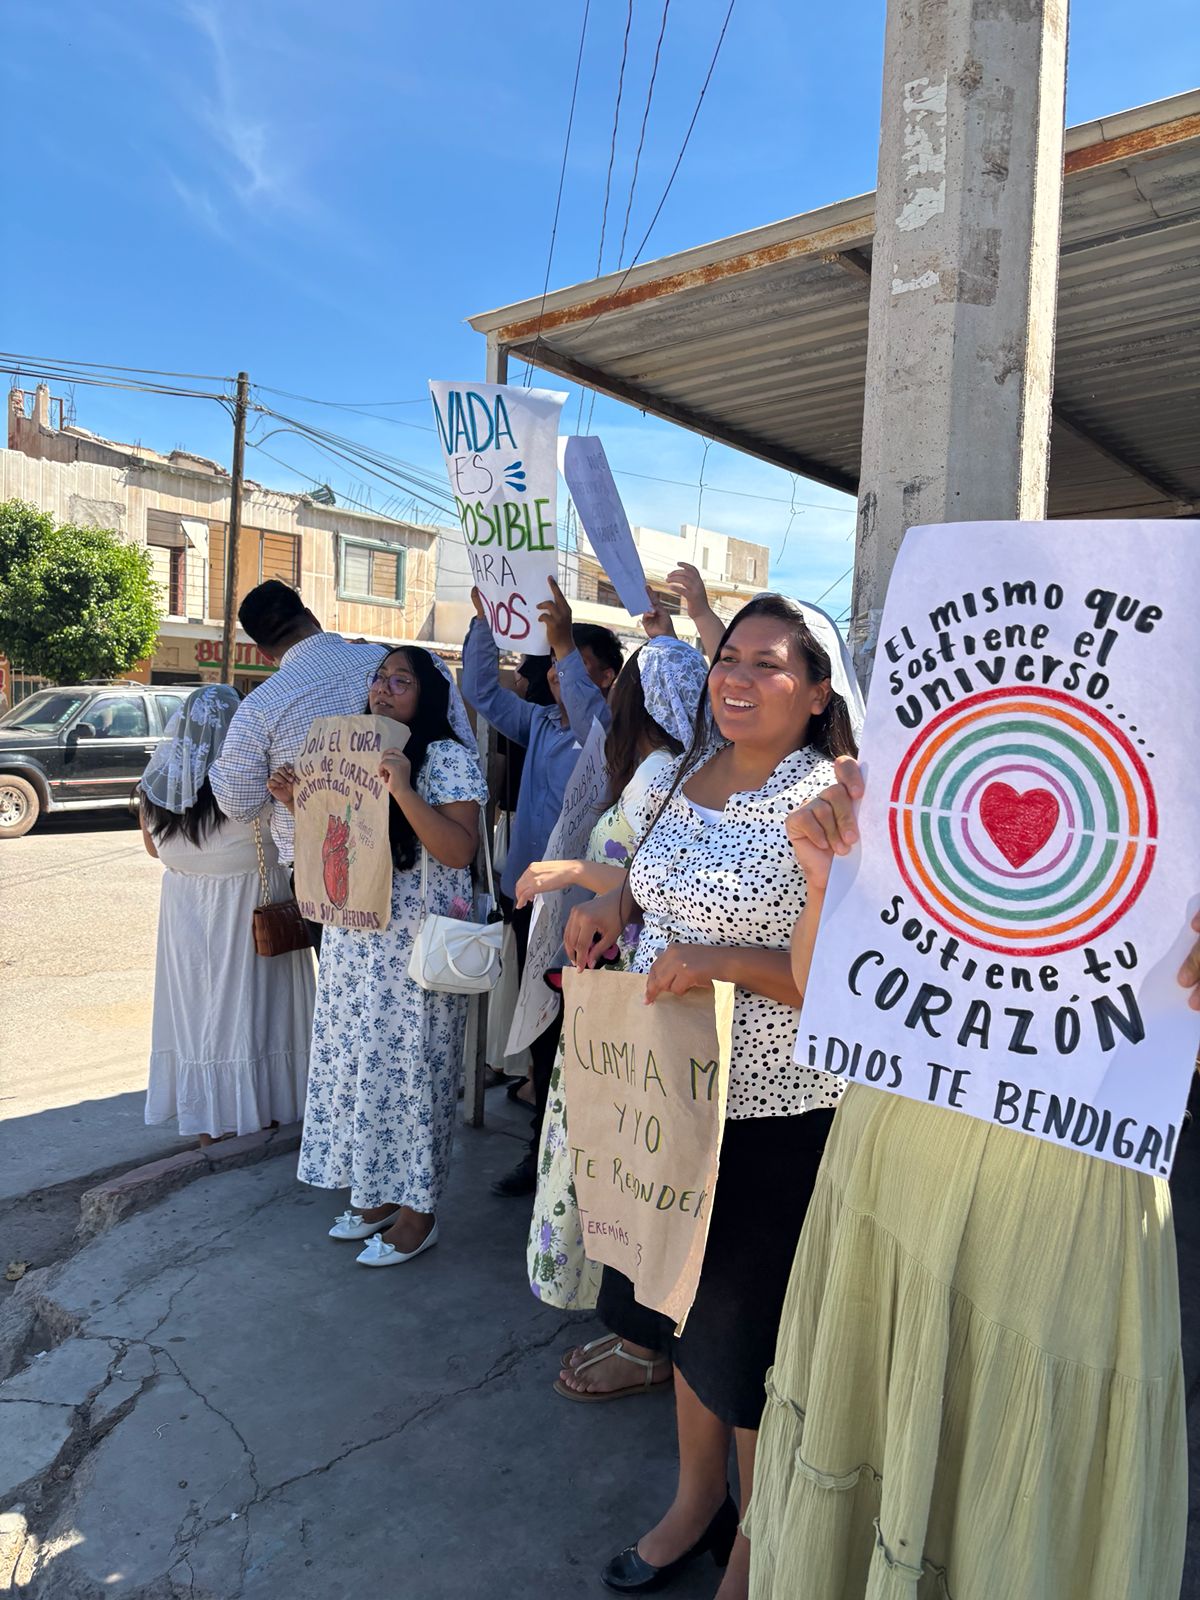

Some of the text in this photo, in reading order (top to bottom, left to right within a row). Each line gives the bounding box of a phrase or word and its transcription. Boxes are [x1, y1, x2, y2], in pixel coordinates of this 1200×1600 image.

[430, 390, 518, 456] NADA
[454, 454, 494, 496] ES
[467, 548, 518, 588] PARA
[884, 579, 1163, 664] El mismo que
[889, 623, 1118, 695] sostiene el
[350, 730, 382, 753] CURA
[296, 773, 350, 811] quebrantado
[321, 755, 334, 773] de
[339, 757, 383, 800] CORAZÓN
[320, 902, 335, 922] SUS
[342, 908, 380, 930] HERIDAS
[880, 895, 1138, 992] sostiene tu
[847, 950, 1145, 1055] CORAZÓN
[573, 1005, 636, 1087] CLAMA
[644, 1049, 667, 1097] A
[807, 1034, 1175, 1176] ¡DIOS TE BENDIGA!
[571, 1146, 596, 1179] TE
